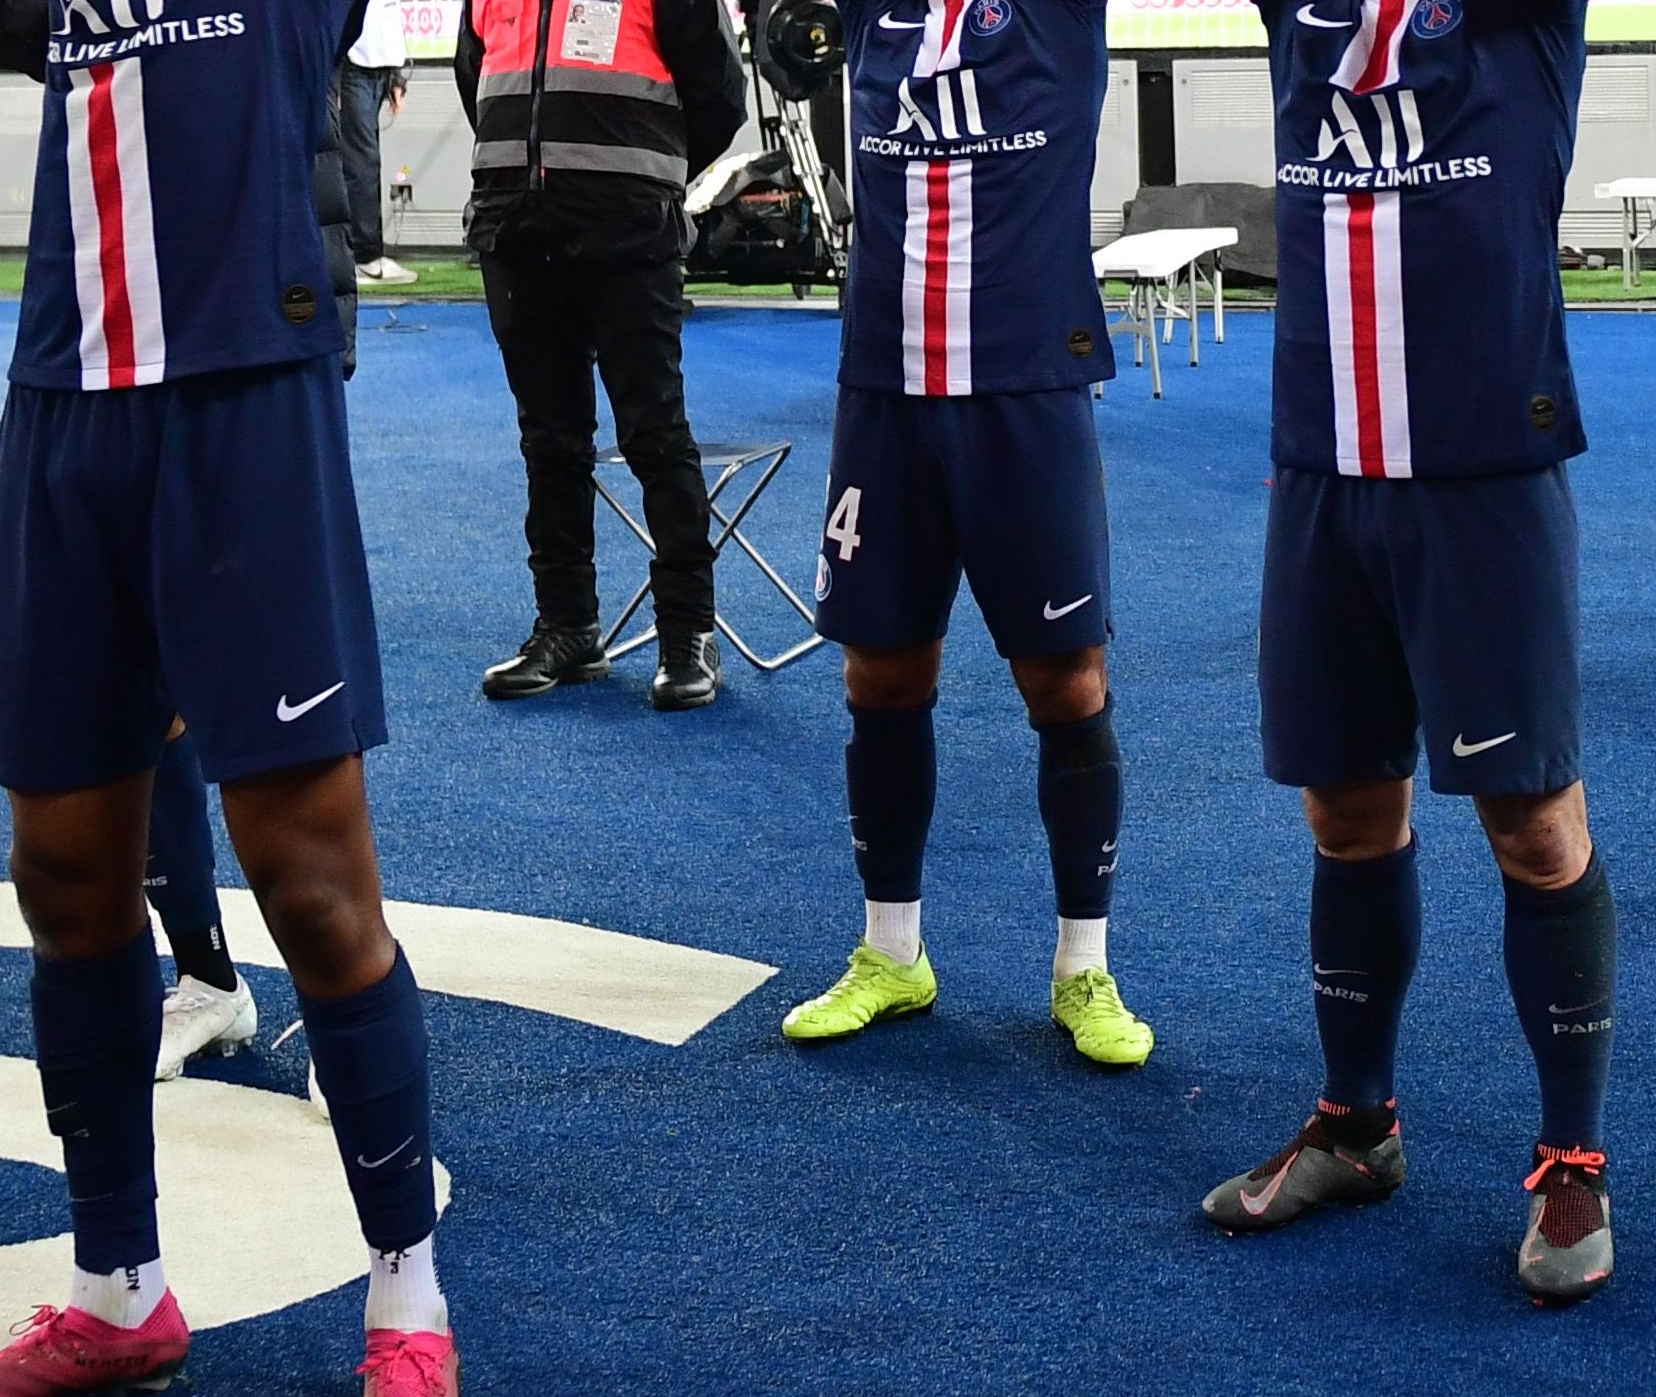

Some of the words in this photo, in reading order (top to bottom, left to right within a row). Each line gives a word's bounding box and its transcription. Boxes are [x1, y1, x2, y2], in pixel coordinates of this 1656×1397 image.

[63, 40, 116, 63] LIVE
[116, 12, 246, 53] LIMITLESS
[858, 134, 902, 156] ACCOR
[949, 130, 1047, 155] LIMITLESS
[1323, 168, 1372, 188] LIVE
[1374, 155, 1493, 188] LIMITLESS
[820, 473, 862, 562] 4
[1313, 979, 1370, 1004] PARIS
[1552, 1016, 1612, 1036] PARIS
